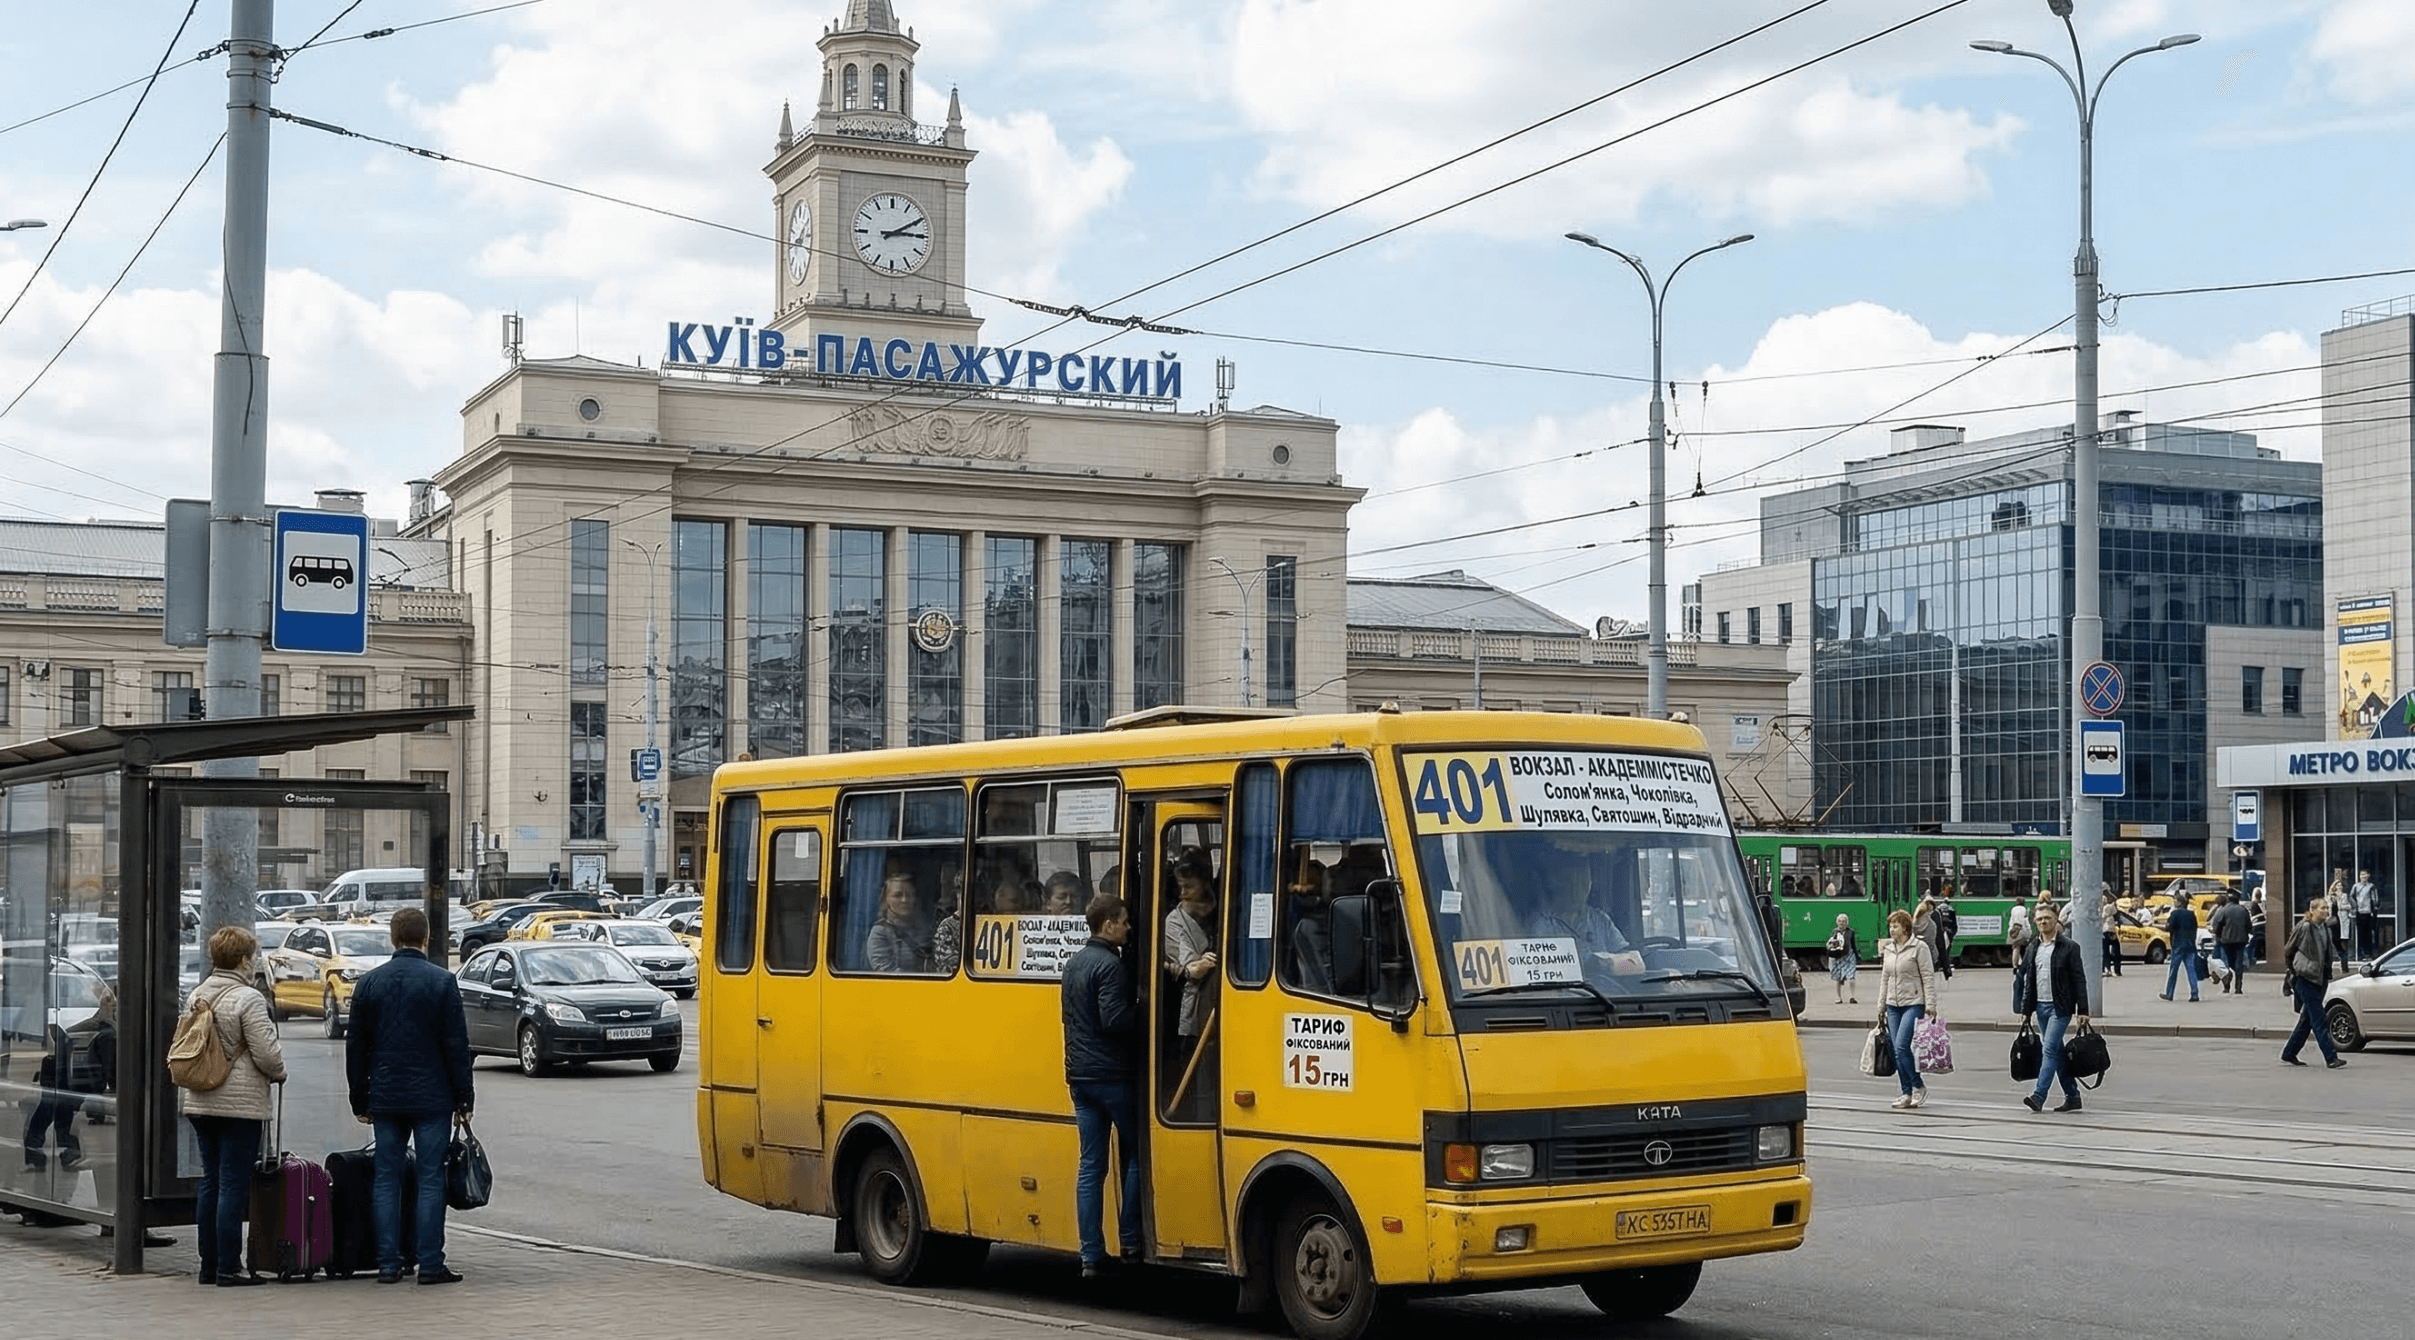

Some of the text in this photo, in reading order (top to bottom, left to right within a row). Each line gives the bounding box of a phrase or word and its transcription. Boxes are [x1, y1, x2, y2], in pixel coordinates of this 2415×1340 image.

[1511, 756, 1576, 777] ВОКЗАЛ
[1588, 757, 1711, 785] АКАДЕММІСТЕЧКО
[2289, 751, 2359, 774] МЕТРО
[1414, 758, 1512, 825] 401
[1544, 782, 1698, 807] Солом'янка, Чоколівка,
[1520, 806, 1589, 827] Шулявка,
[1592, 806, 1662, 828] Святошин,
[975, 920, 1014, 970] 401
[1461, 947, 1505, 985] 401
[1527, 970, 1541, 980] 15
[1292, 1018, 1345, 1035] ТАРИФ
[1289, 1054, 1349, 1087] 15 ГРН
